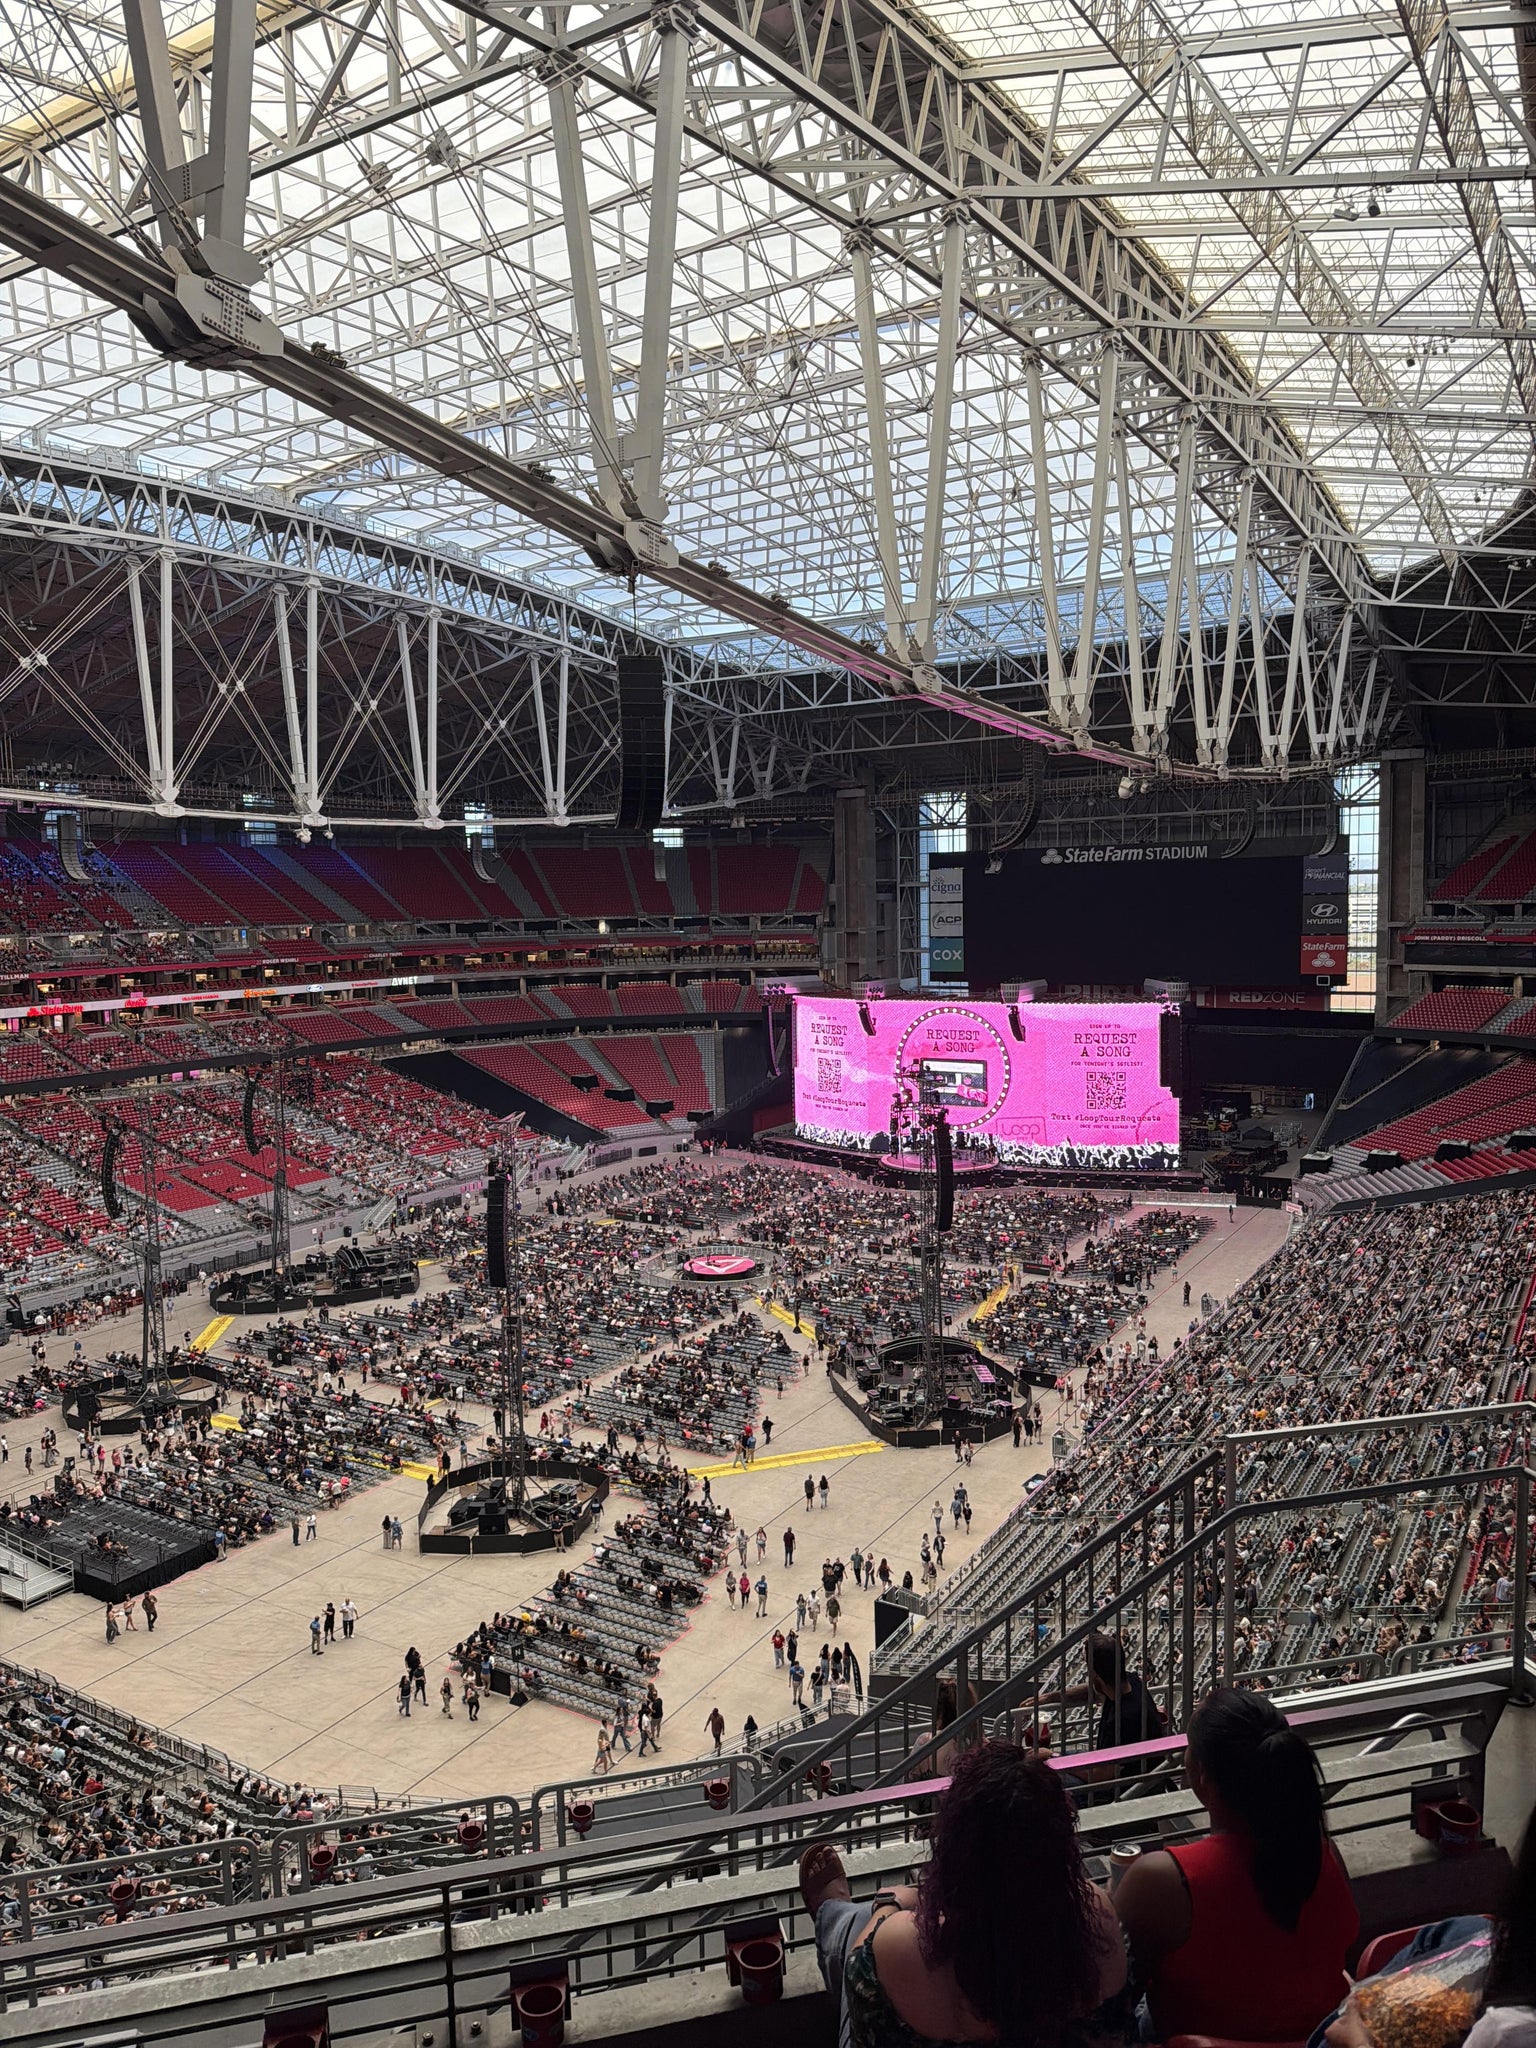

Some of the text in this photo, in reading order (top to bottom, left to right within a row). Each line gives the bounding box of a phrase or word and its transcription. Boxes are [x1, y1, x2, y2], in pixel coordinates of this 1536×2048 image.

[1146, 846, 1208, 860] STADIUM
[932, 881, 961, 894] cigna
[936, 916, 962, 924] ACP
[932, 949, 962, 960] COX
[811, 1022, 848, 1036] REQUEST
[814, 1035, 844, 1046] A SONG
[926, 1029, 980, 1041] REQUEST
[1073, 1033, 1137, 1044] REQUEST
[933, 1042, 975, 1053] A SONG
[1081, 1046, 1131, 1057] A SONG
[1075, 1114, 1161, 1123] #LoopTourRequests
